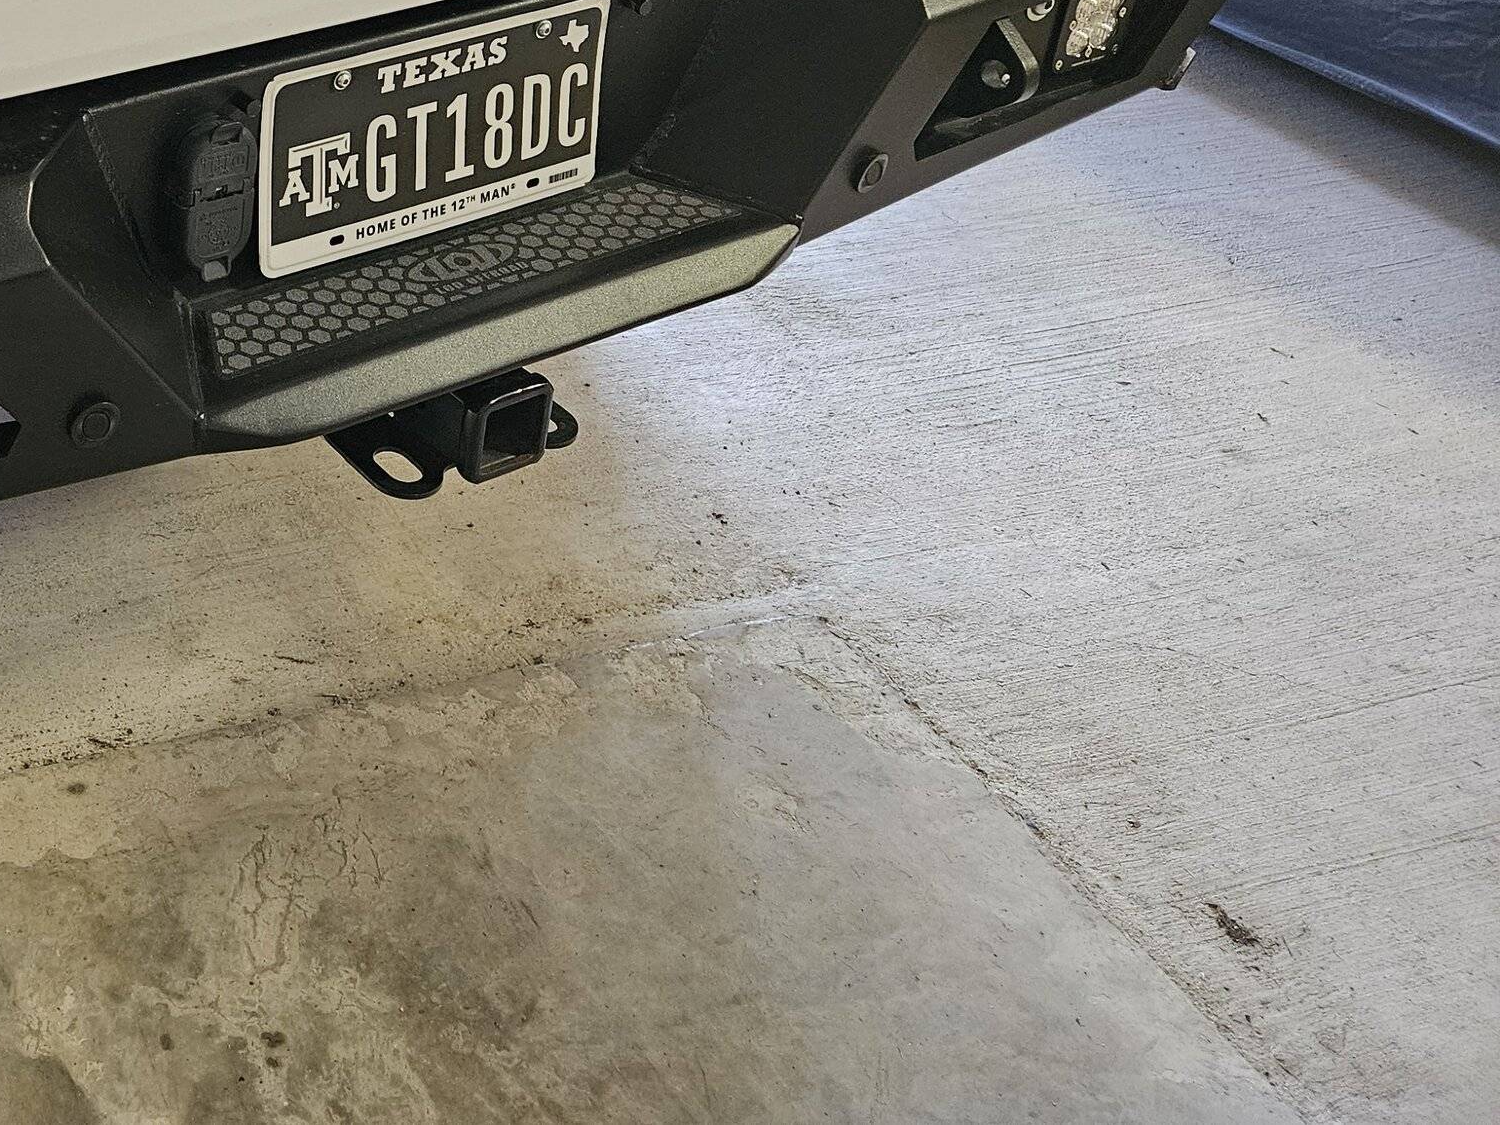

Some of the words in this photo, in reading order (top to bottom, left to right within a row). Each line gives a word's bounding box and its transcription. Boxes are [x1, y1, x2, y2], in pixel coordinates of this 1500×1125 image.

[377, 36, 508, 94] TEXAS
[365, 62, 589, 203] GT18DC
[356, 220, 396, 240] HOME
[401, 214, 419, 227] OF
[422, 203, 447, 220] THE
[451, 194, 476, 213] 12TH
